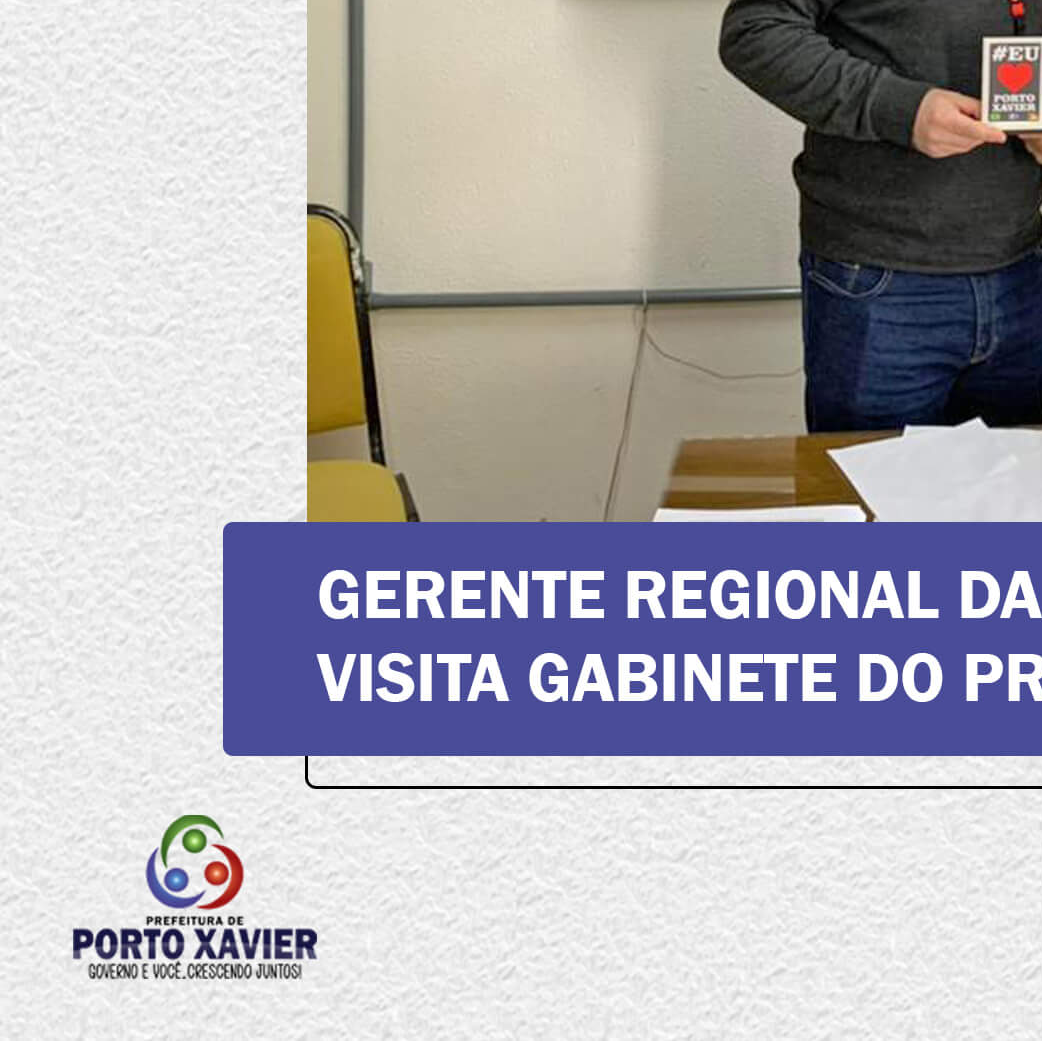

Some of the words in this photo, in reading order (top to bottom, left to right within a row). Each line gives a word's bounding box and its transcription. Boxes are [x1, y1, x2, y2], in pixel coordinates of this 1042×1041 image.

[992, 45, 1039, 62] #EU
[993, 94, 1035, 103] PORTO
[992, 103, 1036, 112] XAVIER
